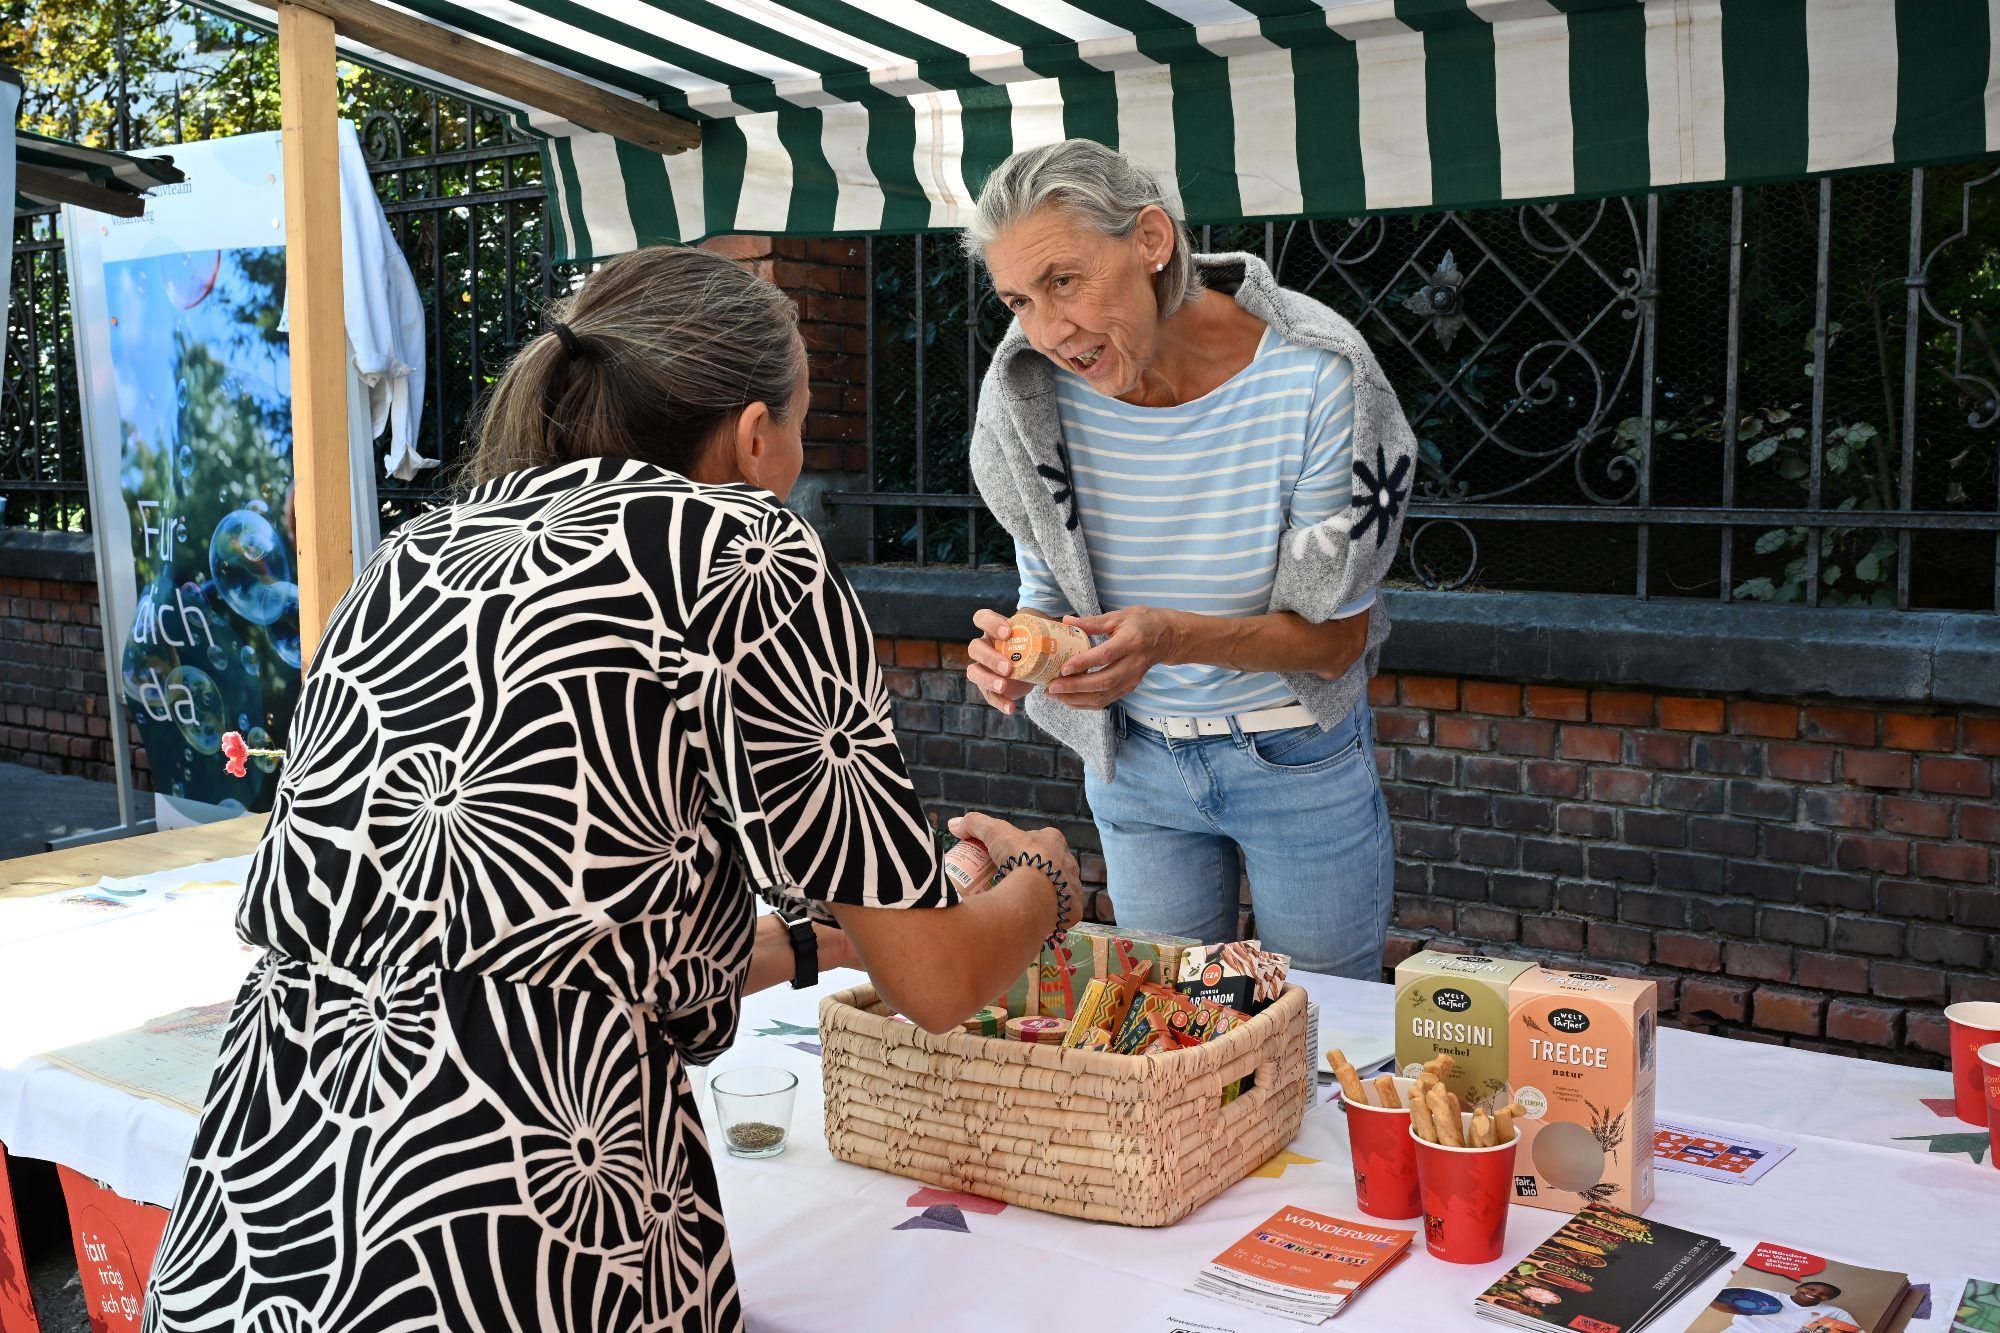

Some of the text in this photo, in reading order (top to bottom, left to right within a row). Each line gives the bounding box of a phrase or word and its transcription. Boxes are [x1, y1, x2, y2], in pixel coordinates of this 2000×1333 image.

[138, 500, 178, 562] Für
[133, 583, 215, 647] dich
[139, 667, 199, 726] da
[1412, 1017, 1493, 1047] GRISSINI
[1433, 1044, 1470, 1057] Fenchel
[1529, 1038, 1608, 1069] TRECCE
[1552, 1069, 1583, 1079] natur
[1524, 1099, 1543, 1107] EUROPA
[1522, 1187, 1537, 1196] bio
[1285, 1213, 1396, 1243] WONDERVILLE
[82, 1231, 109, 1263] fair
[1772, 1254, 1792, 1262] Welt
[101, 1292, 121, 1314] sich
